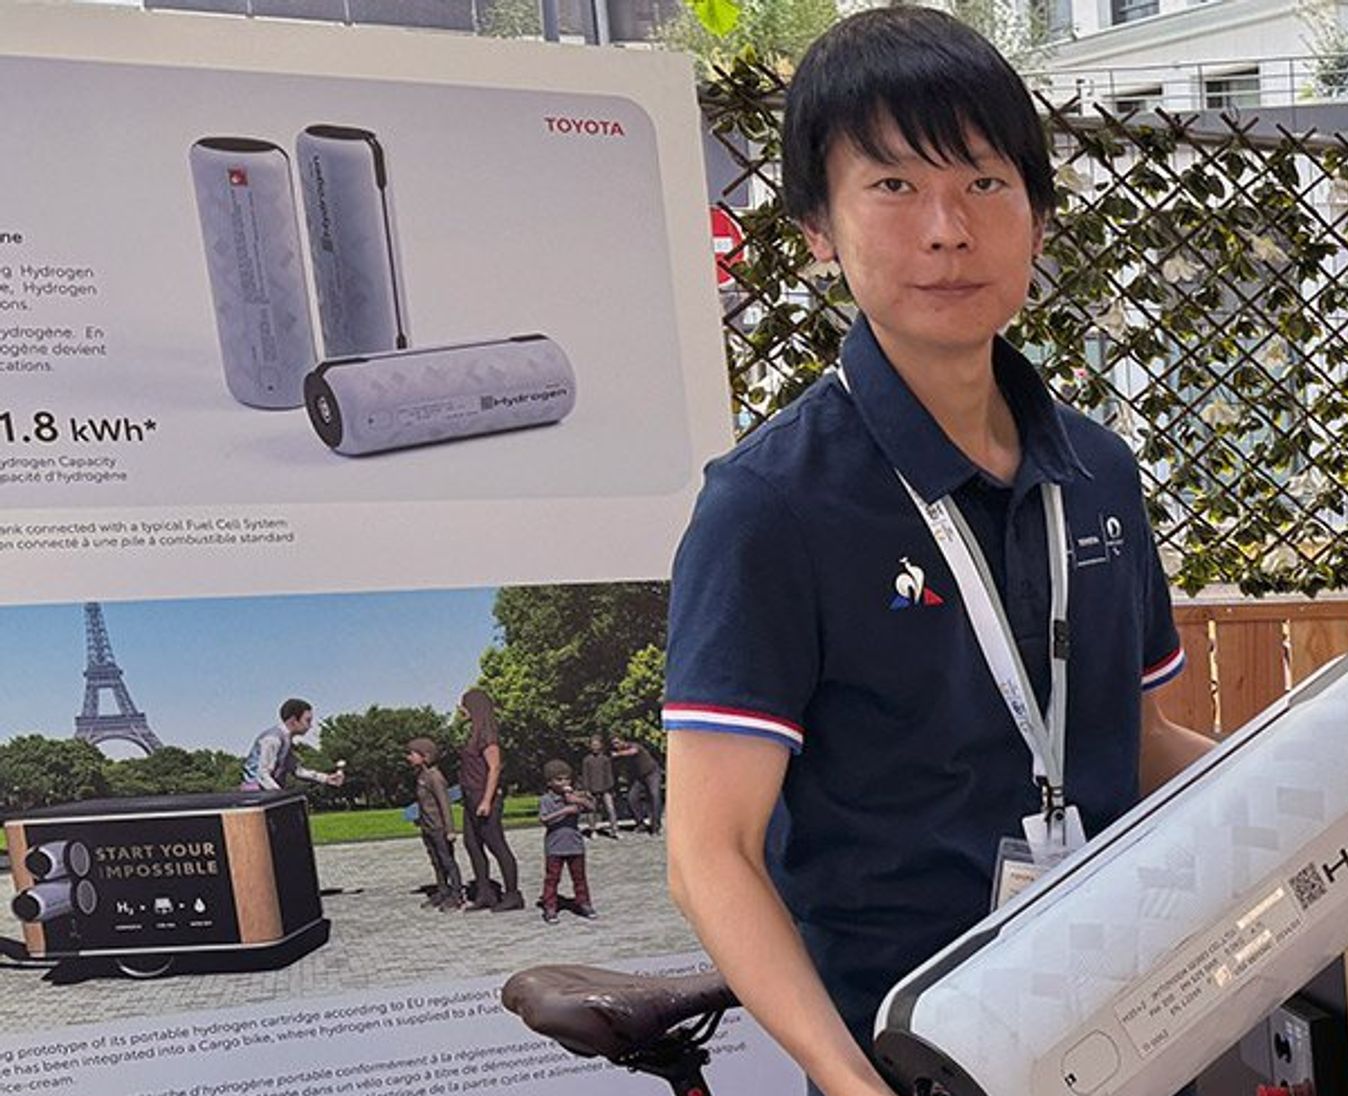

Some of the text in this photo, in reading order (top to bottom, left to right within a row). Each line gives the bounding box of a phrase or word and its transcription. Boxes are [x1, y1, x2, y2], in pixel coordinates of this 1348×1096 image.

[543, 116, 626, 137] TOYOTA
[20, 264, 94, 281] Hydrogen
[23, 281, 98, 297] Hydrogen
[85, 325, 105, 339] En
[51, 343, 107, 356] devient
[0, 411, 59, 443] 1.8
[57, 455, 116, 469] Capacity
[25, 522, 97, 536] connected
[99, 521, 127, 535] with
[130, 522, 138, 533] a
[141, 519, 183, 534] typical
[186, 518, 214, 531] Fuel
[215, 517, 242, 531] Cell
[242, 517, 288, 532] System
[16, 537, 79, 550] connecté
[92, 537, 118, 548] une
[121, 535, 146, 549] pile
[158, 532, 238, 547] combustible
[239, 531, 296, 545] standard
[95, 842, 216, 862] START YOUR
[17, 1041, 89, 1061] prototype
[90, 1036, 107, 1050] of
[109, 1035, 127, 1048] its
[129, 1026, 189, 1046] portable
[192, 1019, 258, 1037] hydrogen
[259, 1011, 321, 1028] cartridge
[323, 1003, 389, 1020] according
[390, 1000, 405, 1012] to
[406, 997, 425, 1010] EU
[426, 989, 492, 1008] regulation
[13, 1063, 40, 1076] has
[42, 1057, 80, 1073] been
[82, 1049, 156, 1067] integrated
[157, 1044, 186, 1057] into
[187, 1044, 197, 1052] a
[198, 1036, 241, 1051] Cargo
[242, 1033, 276, 1046] bike,
[277, 1027, 318, 1041] where
[318, 1018, 382, 1037] hydrogen
[395, 1007, 451, 1026] supplied
[451, 1008, 466, 1020] to
[276, 1068, 334, 1087] portable
[335, 1054, 429, 1077] conformément
[440, 1051, 453, 1063] la
[453, 1041, 548, 1062] réglementation
[336, 1082, 354, 1094] un
[354, 1076, 384, 1090] vélo
[384, 1071, 422, 1087] cargo
[461, 1064, 479, 1076] de
[428, 1083, 446, 1096] de
[448, 1080, 460, 1093] la
[461, 1074, 499, 1092] partie
[532, 1068, 546, 1080] et
